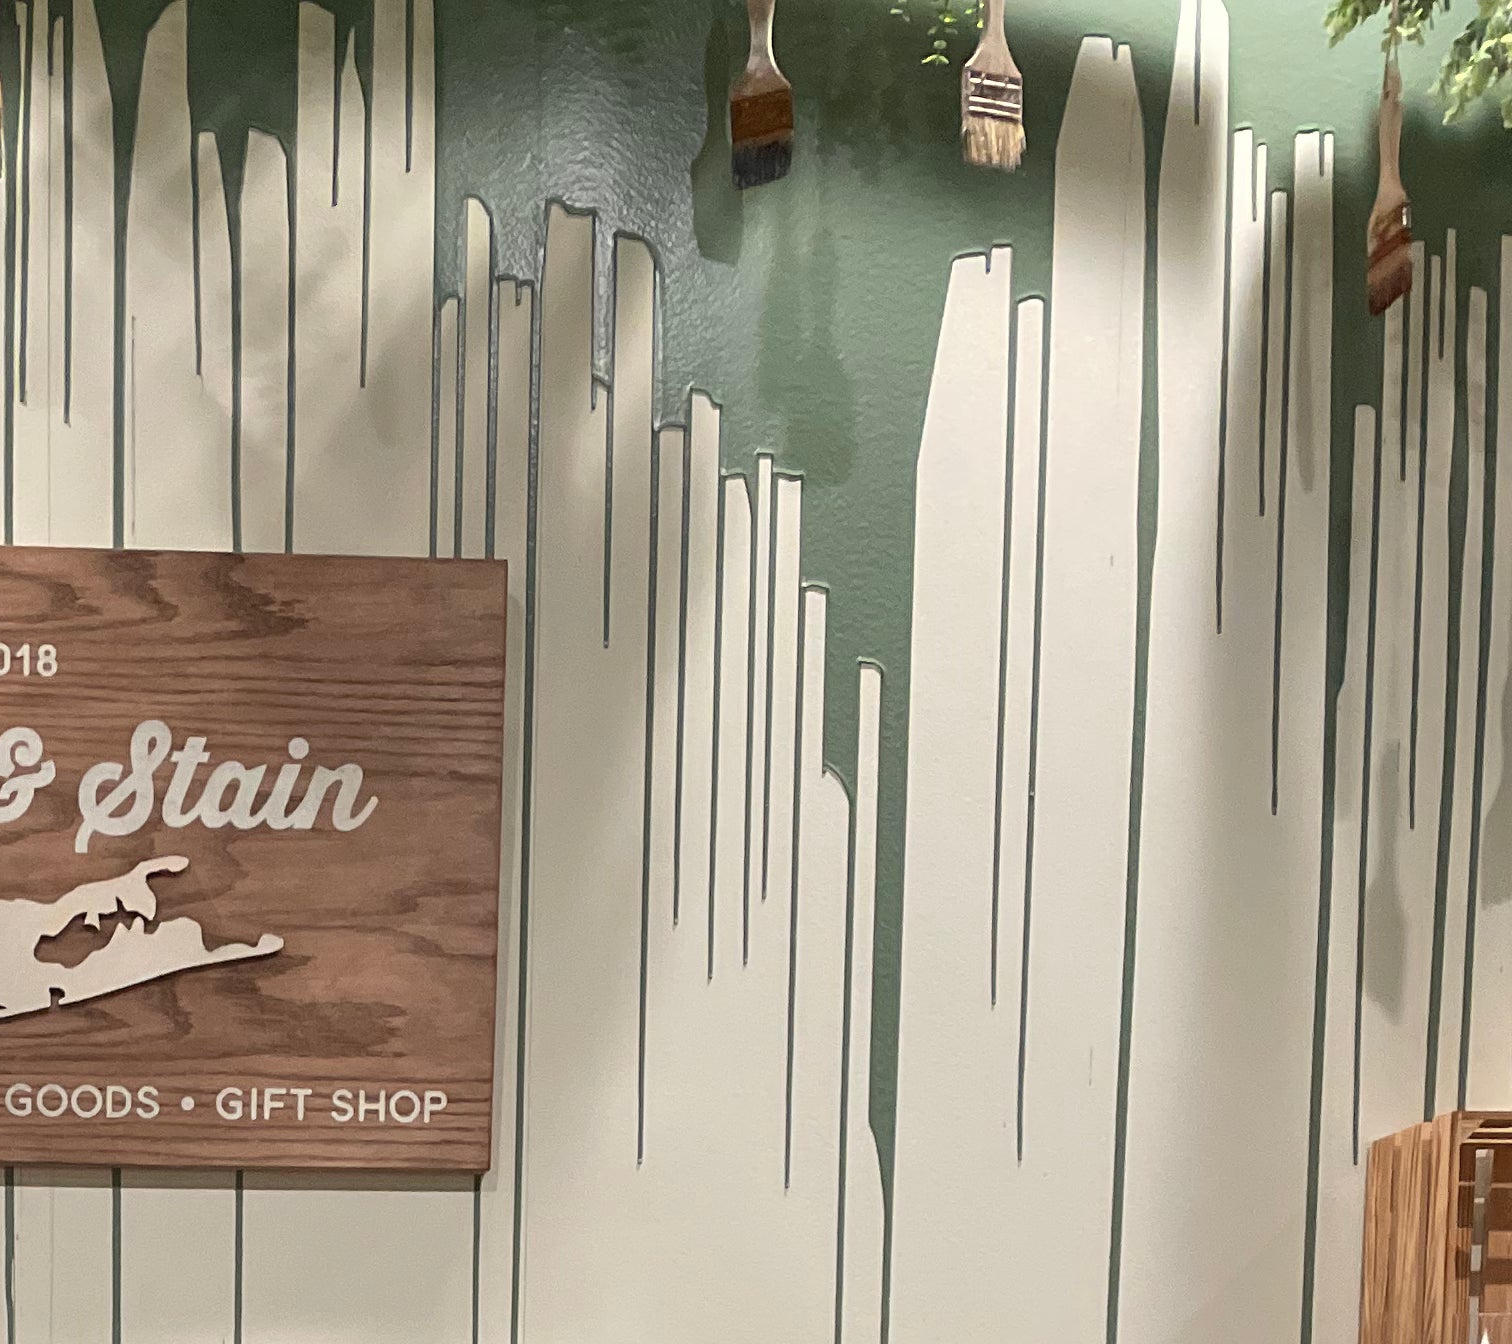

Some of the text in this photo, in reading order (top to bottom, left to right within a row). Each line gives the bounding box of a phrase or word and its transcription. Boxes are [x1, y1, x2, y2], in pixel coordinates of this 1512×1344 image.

[74, 719, 379, 854] Stain
[3, 1083, 161, 1119] GOODS
[215, 1086, 313, 1122] GIFT
[330, 1088, 448, 1124] SHOP
